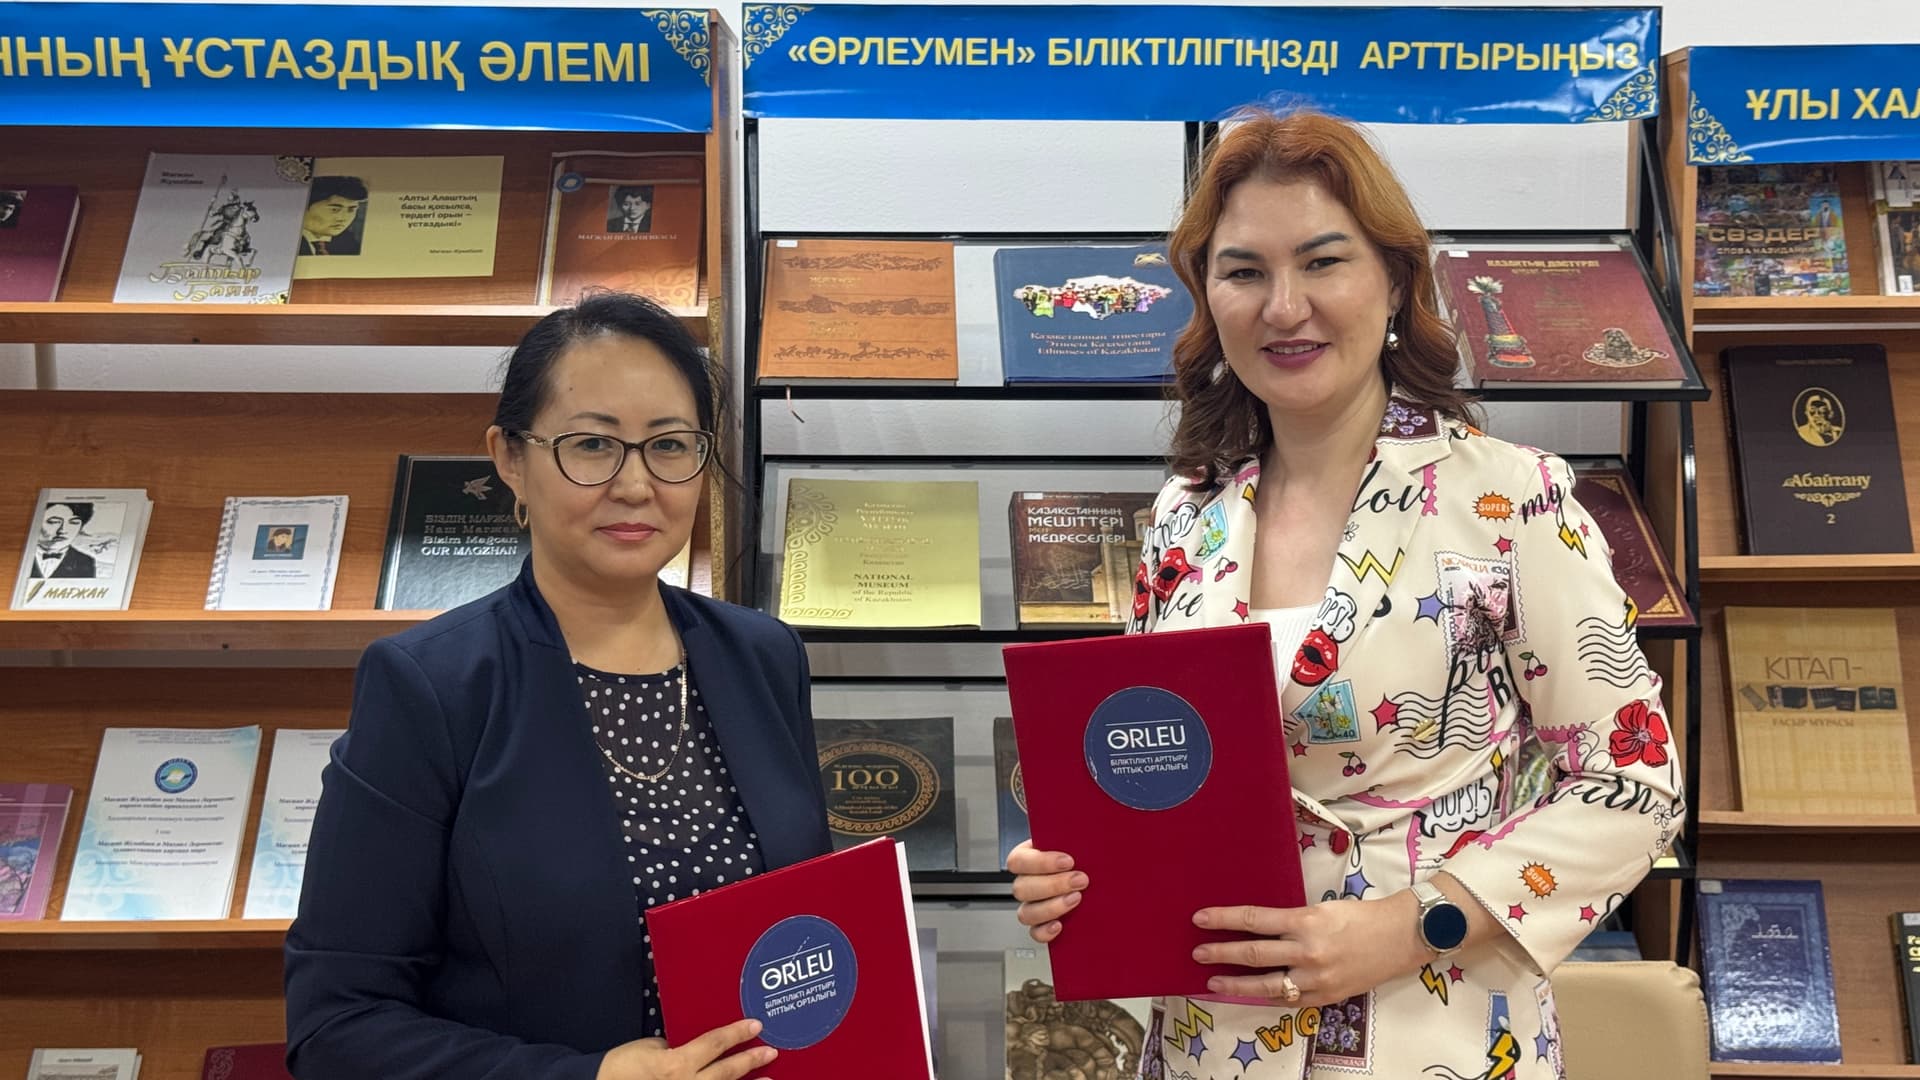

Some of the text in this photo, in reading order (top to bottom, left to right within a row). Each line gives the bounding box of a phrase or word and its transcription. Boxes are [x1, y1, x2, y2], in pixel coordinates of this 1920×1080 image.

[161, 37, 466, 92] ҰСТАЗДЫҚ
[479, 40, 651, 83] ӘЛЕМІ
[787, 36, 1640, 77] «ӨРЛЕУМЕН» БІЛІКТІЛІГІҢІЗДІ АРТТЫРЫҢЫЗ
[1745, 88, 1841, 121] ҰЛЫ
[1708, 227, 1821, 244] СӨЗДЕР
[1027, 516, 1124, 528] МЕШІТТЕРІ
[1826, 513, 1837, 524] 2
[1028, 534, 1126, 544] МЕДРЕСЕЛЕРІ
[420, 546, 518, 556] OUR MAGZHAN
[1763, 656, 1863, 681] КІТАП-
[1154, 754, 1188, 764] АРТТЫРУ
[830, 768, 900, 791] 100
